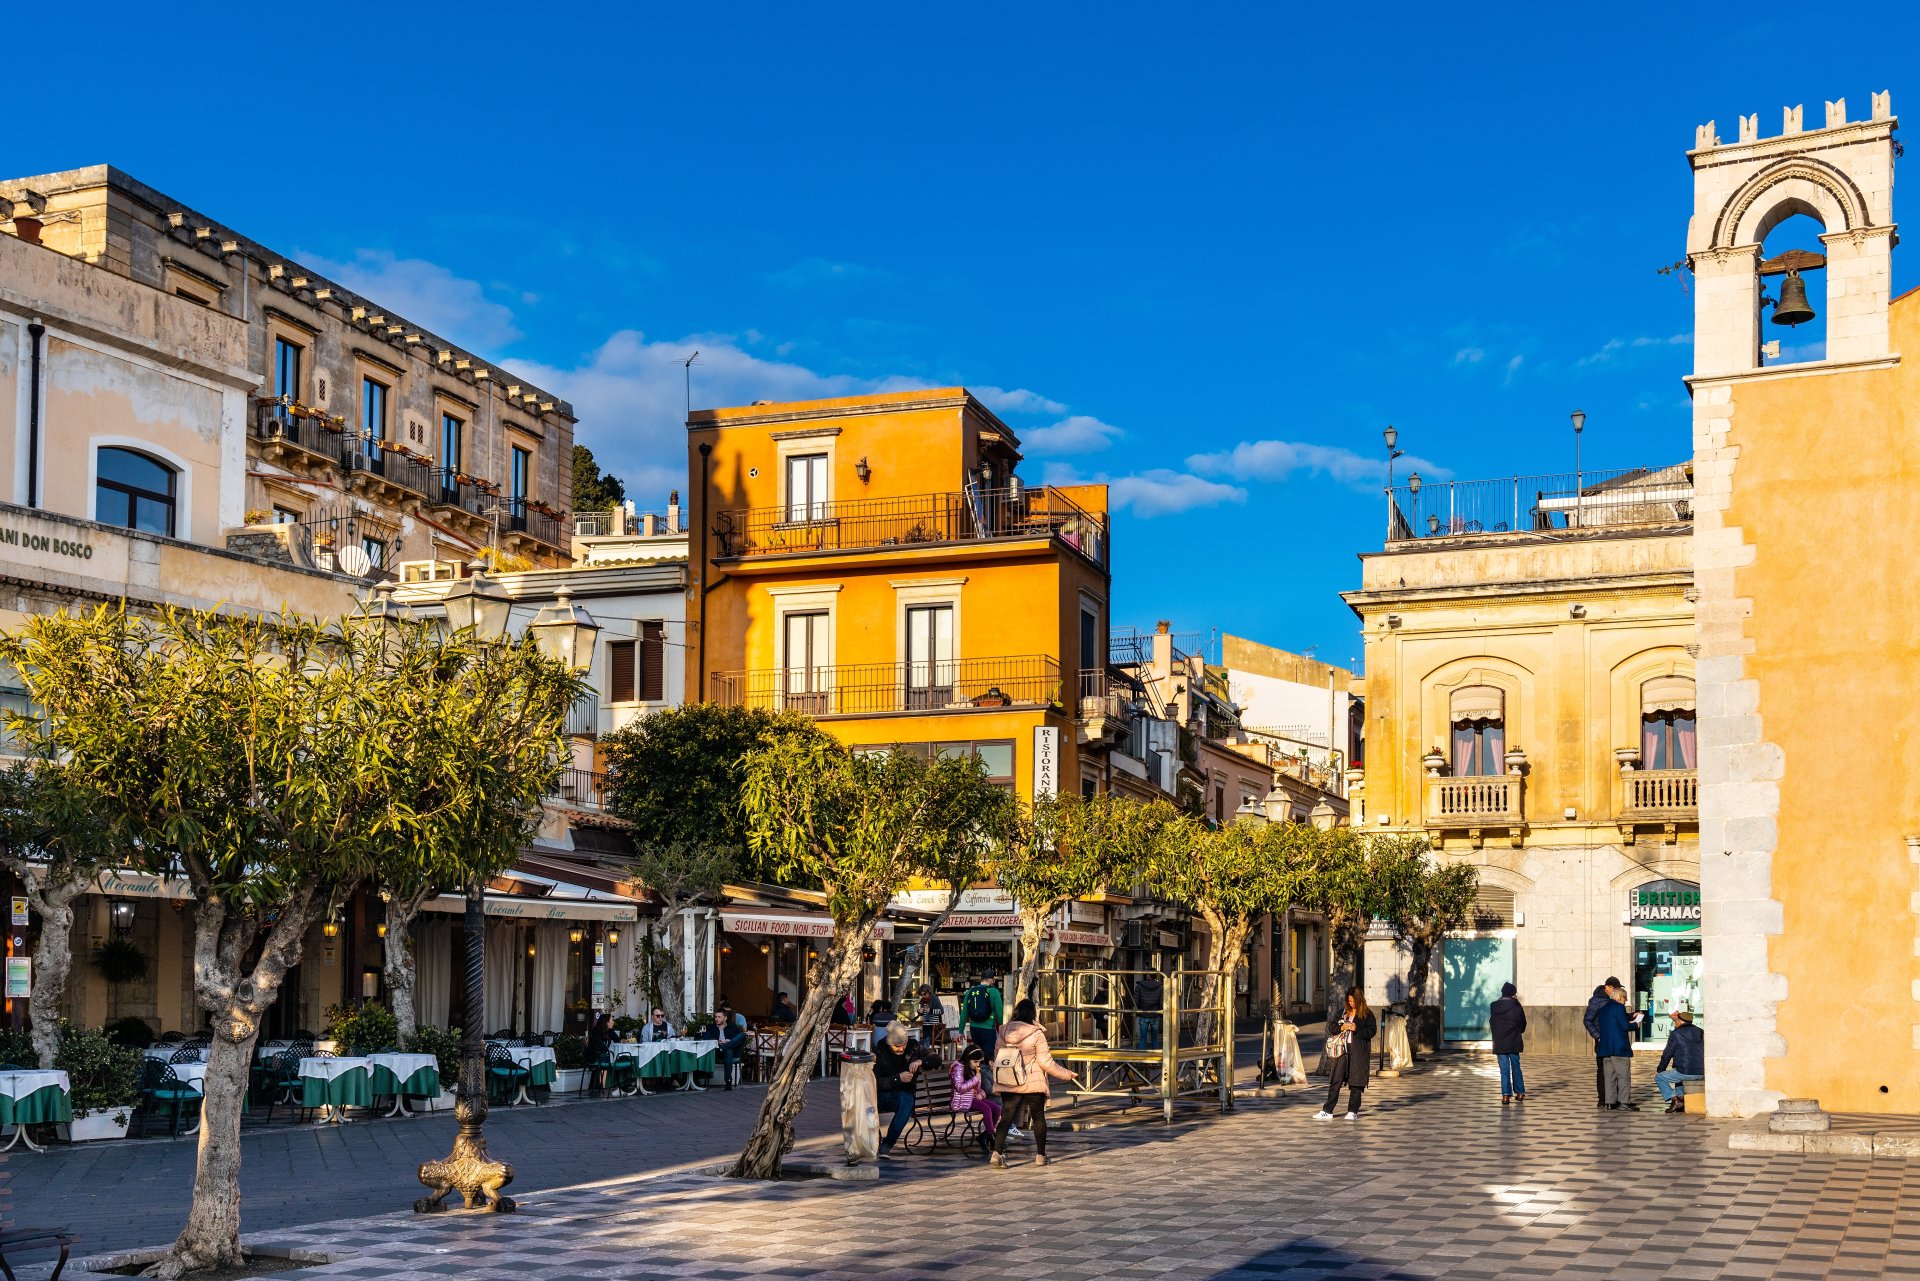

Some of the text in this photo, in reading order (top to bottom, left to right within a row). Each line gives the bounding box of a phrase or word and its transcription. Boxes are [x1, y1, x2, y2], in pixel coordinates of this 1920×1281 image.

[22, 532, 50, 552] DON
[53, 538, 93, 560] BOSCO
[1041, 729, 1052, 801] RISTORANT
[1639, 891, 1701, 906] BRITISH
[545, 904, 566, 918] Bar
[1631, 906, 1701, 920] PHARMAC
[734, 920, 768, 932] SICILIAN
[771, 922, 790, 934] FOOD
[793, 924, 809, 935] NON
[811, 925, 829, 936] STOP
[873, 928, 885, 939] BAR
